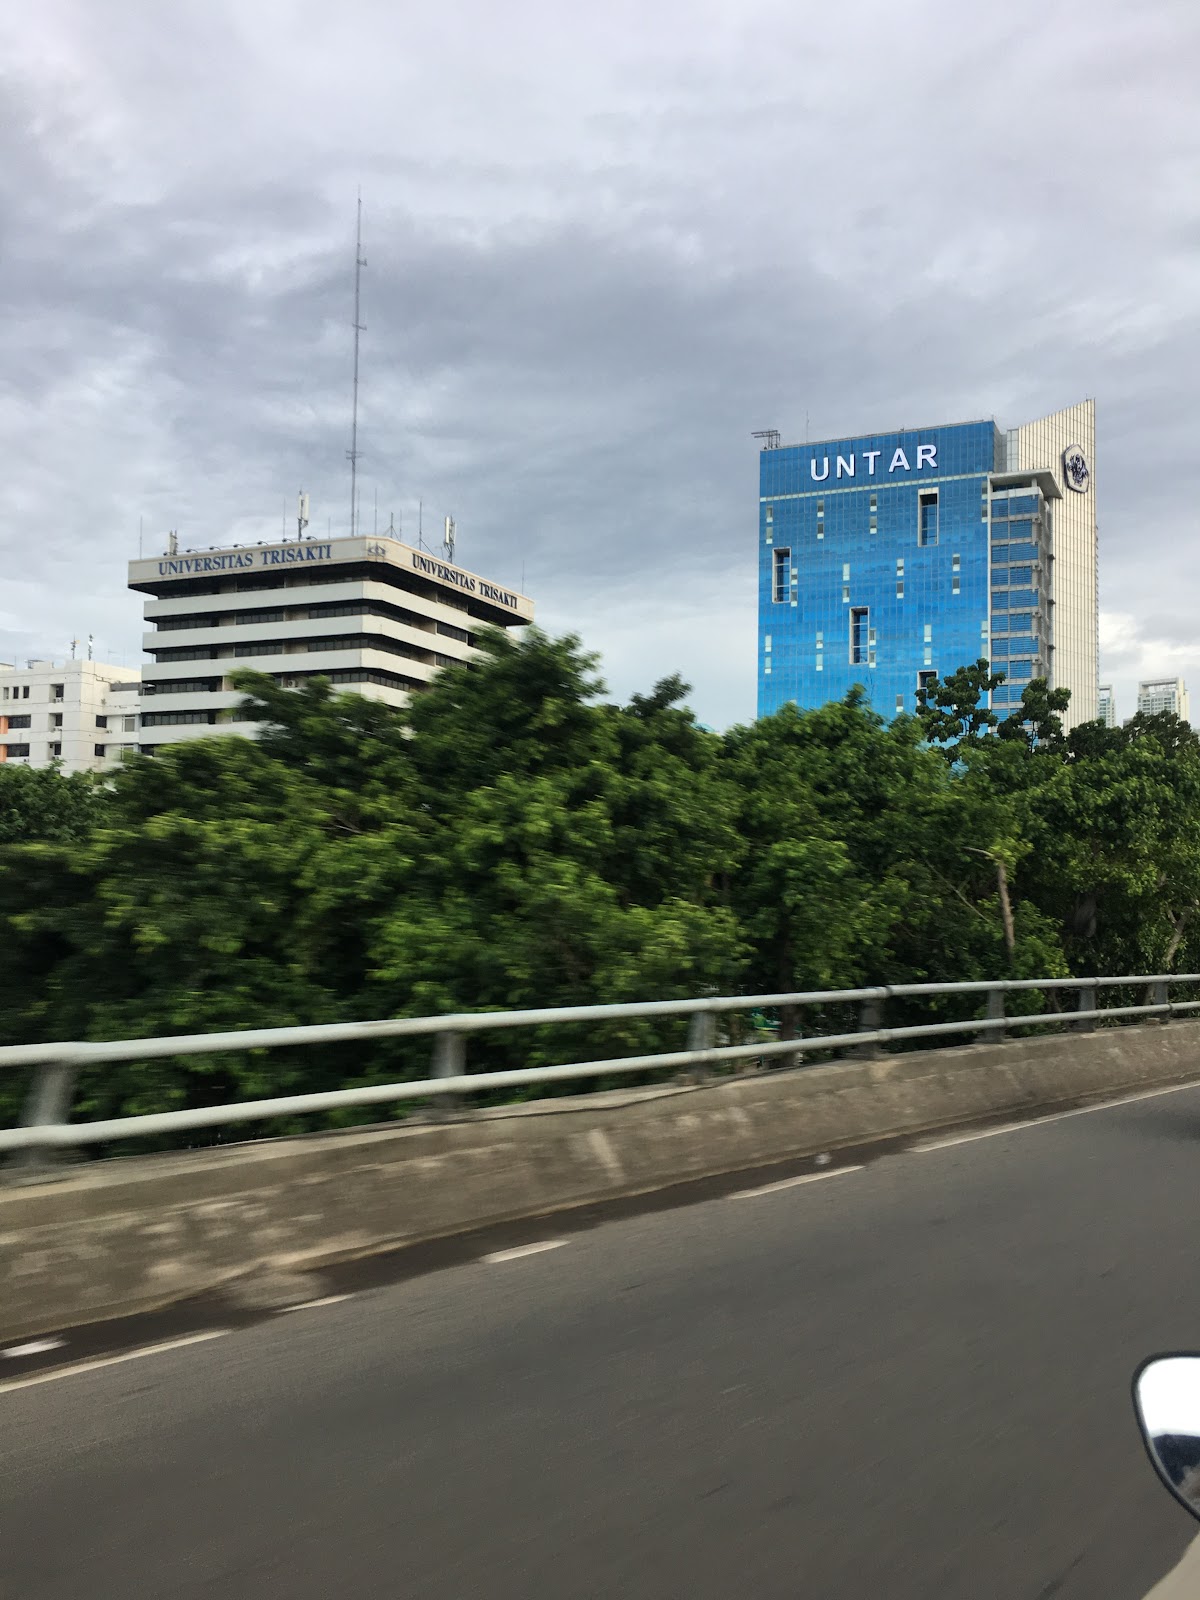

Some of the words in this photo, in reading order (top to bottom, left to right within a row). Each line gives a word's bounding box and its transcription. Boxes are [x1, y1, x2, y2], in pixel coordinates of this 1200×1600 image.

[811, 444, 938, 481] UNTAR
[159, 553, 253, 576] UNIVERSITAS
[261, 545, 332, 565] TRISAKTI
[412, 553, 475, 592] UNIVERSITAS
[479, 582, 518, 609] TRISAKTI
